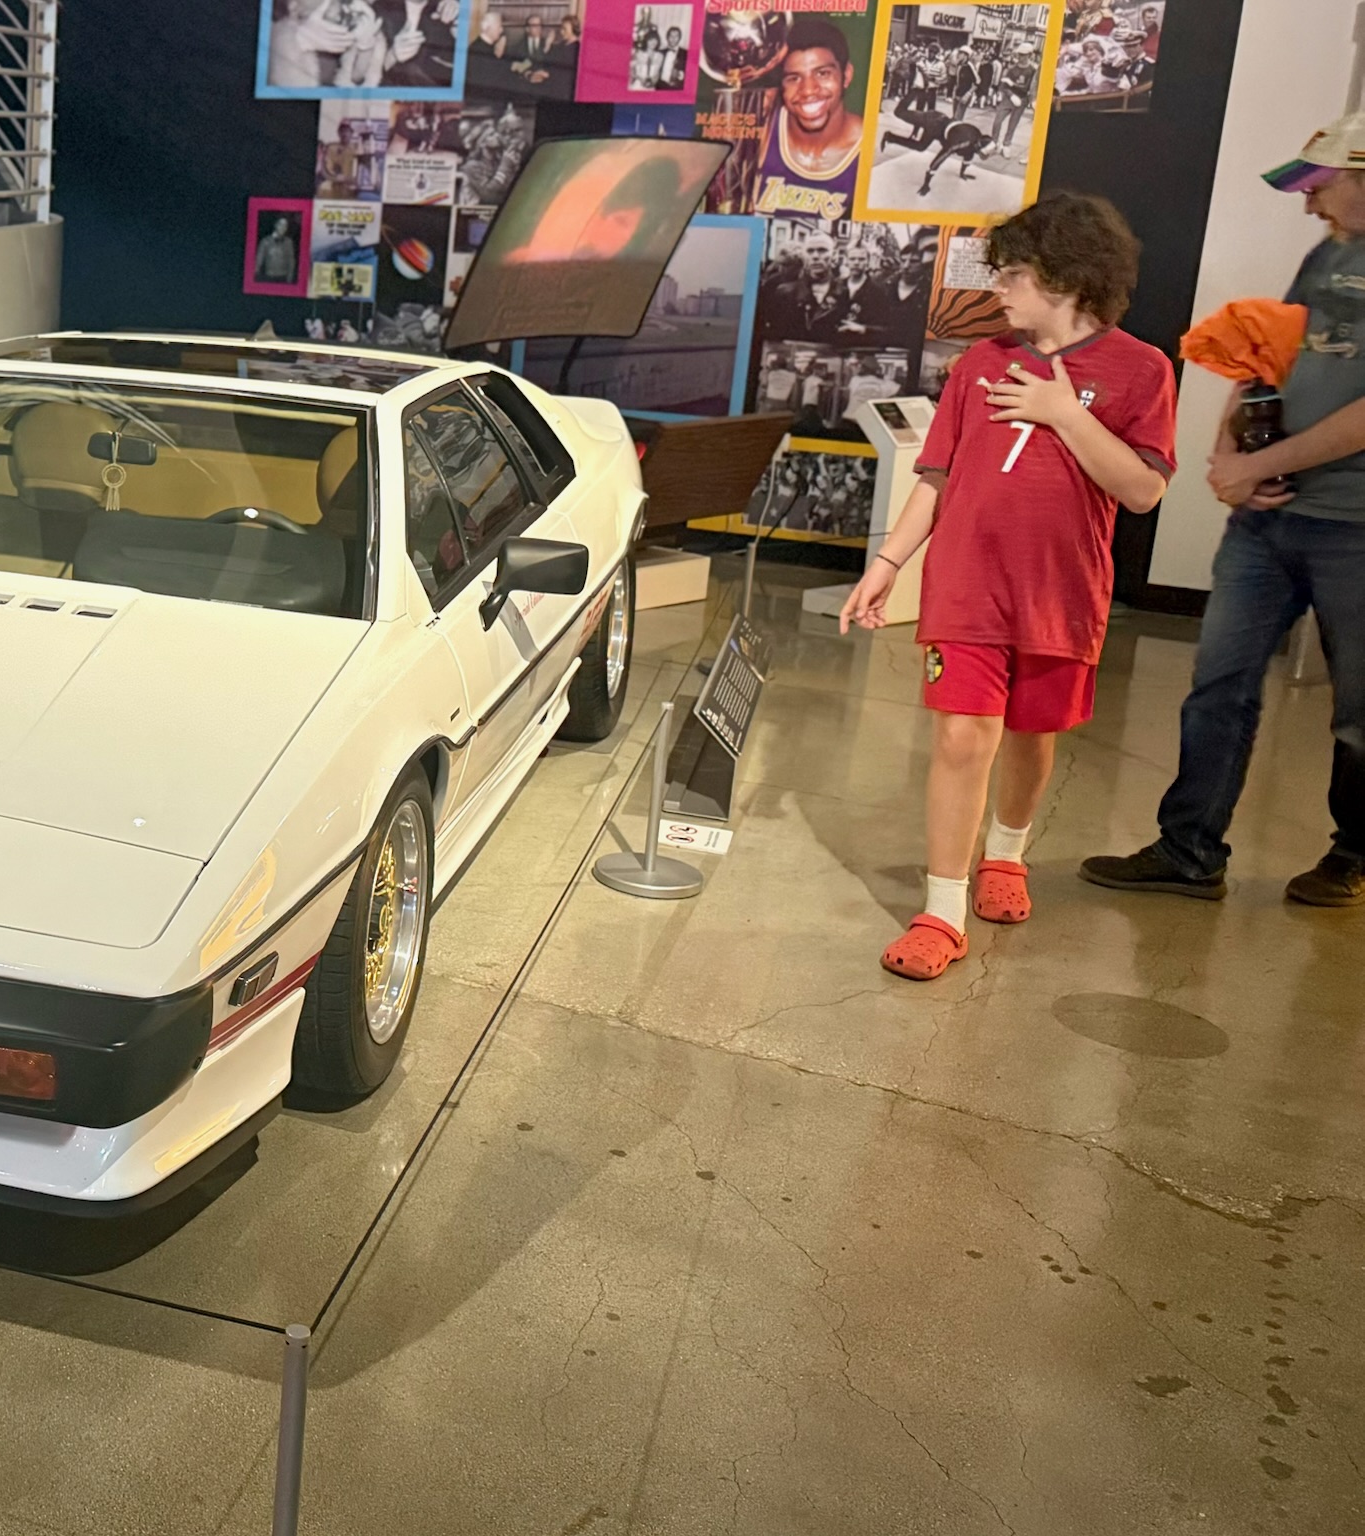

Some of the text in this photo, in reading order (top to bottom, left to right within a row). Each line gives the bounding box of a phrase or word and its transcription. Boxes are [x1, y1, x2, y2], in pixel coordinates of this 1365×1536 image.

[707, 0, 868, 15] Sports Illustrated
[695, 112, 756, 126] MAGIC'S
[702, 126, 764, 139] MOMENT
[756, 176, 848, 221] LAKERS
[1000, 421, 1035, 473] 7
